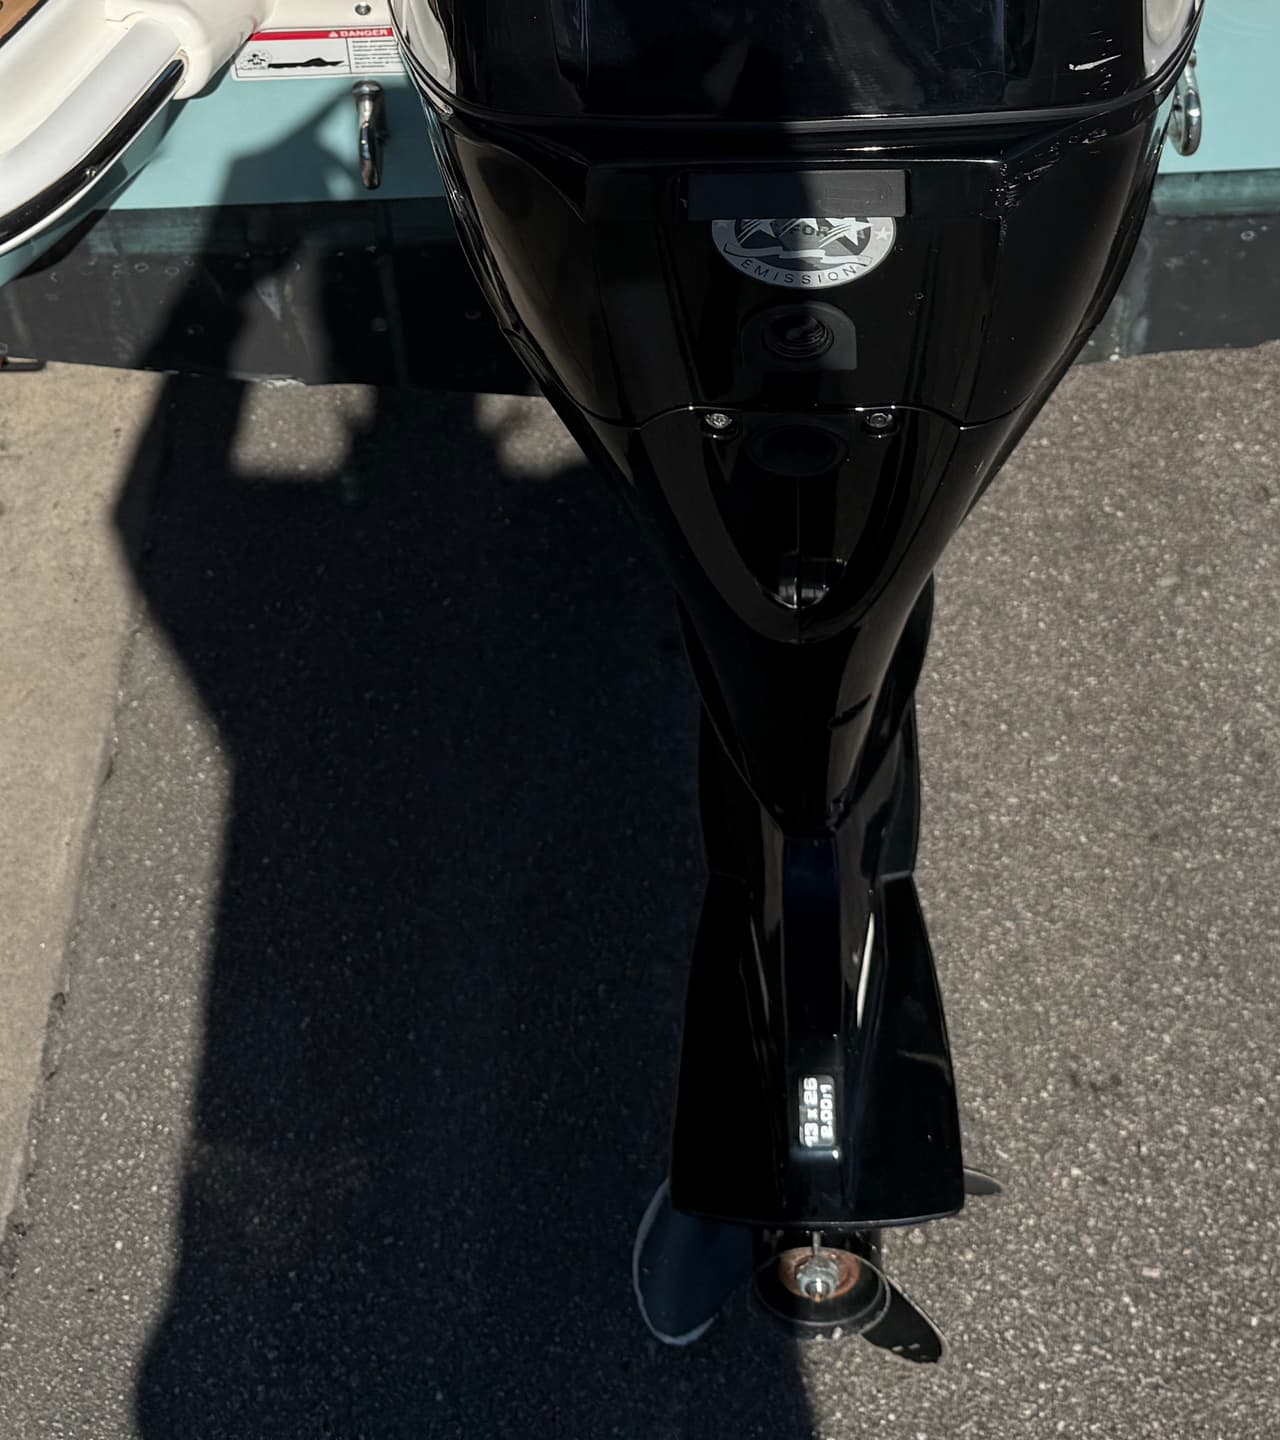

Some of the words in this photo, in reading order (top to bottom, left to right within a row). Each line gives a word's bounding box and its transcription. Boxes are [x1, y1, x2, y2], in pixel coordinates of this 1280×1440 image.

[340, 29, 388, 38] DANGER
[740, 259, 858, 285] EMISSION
[804, 1122, 819, 1148] 13
